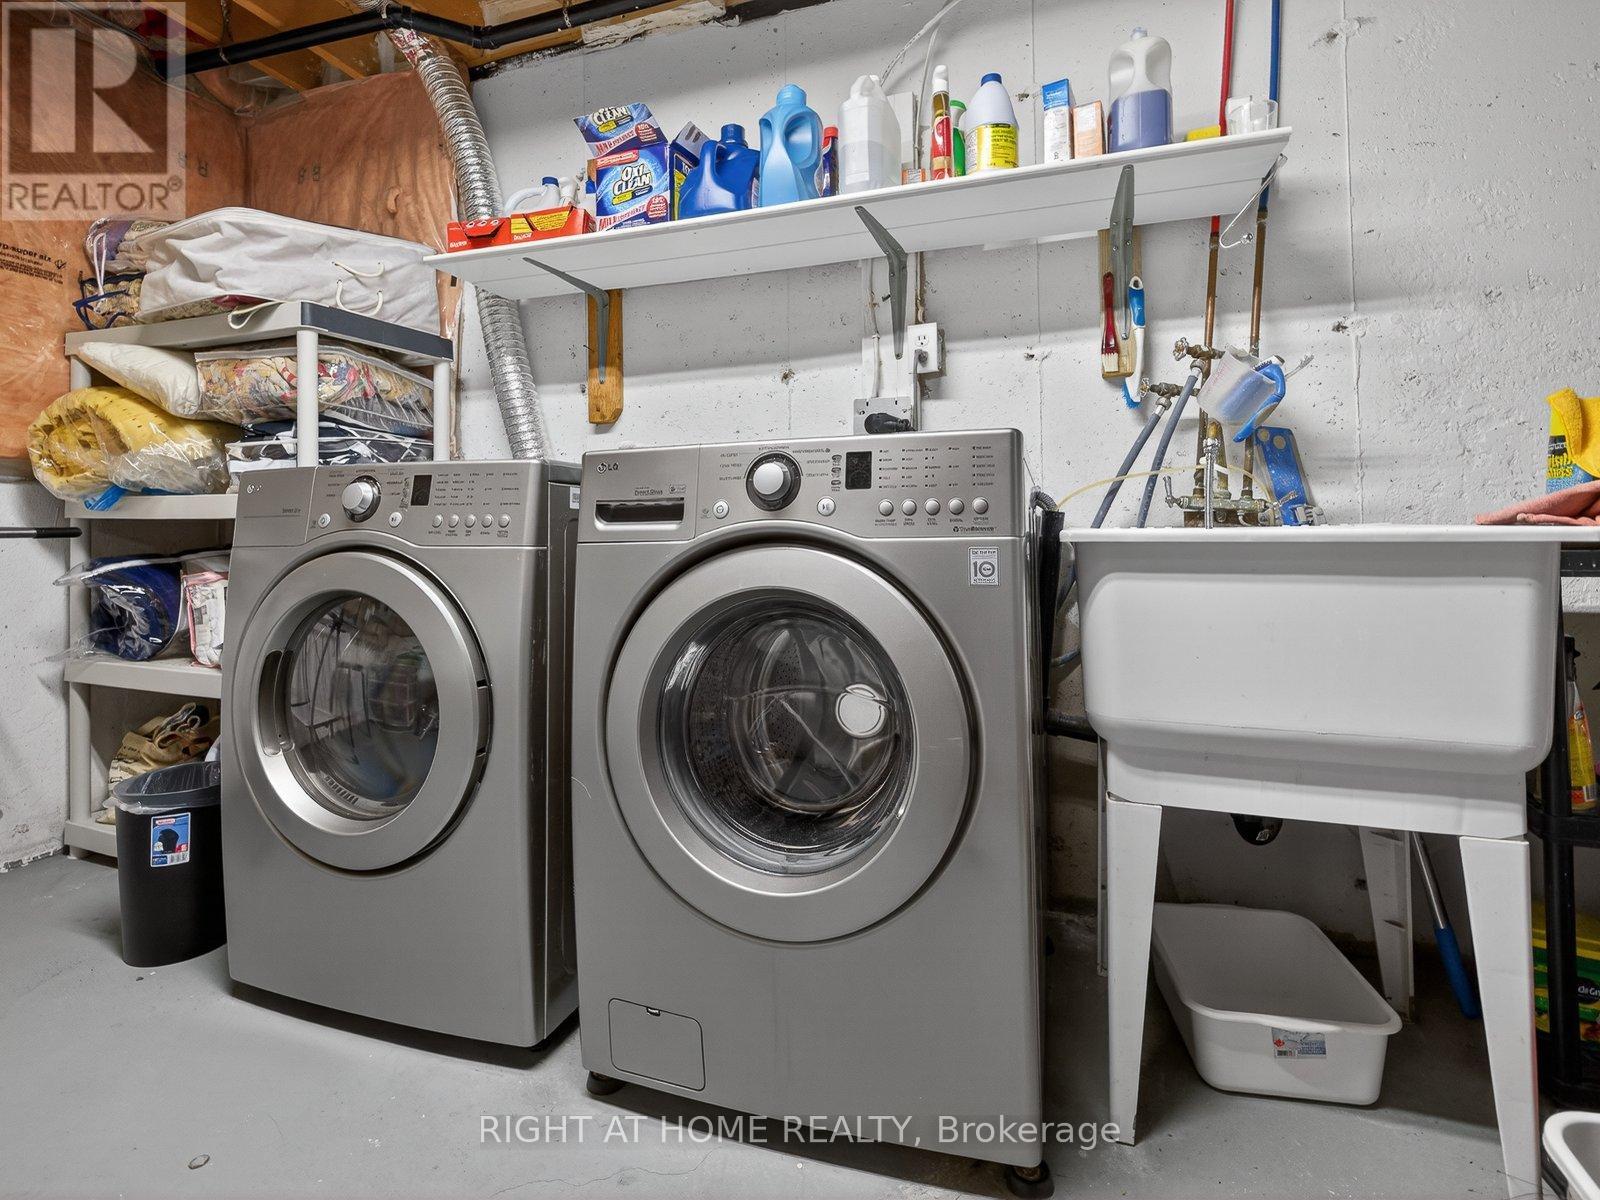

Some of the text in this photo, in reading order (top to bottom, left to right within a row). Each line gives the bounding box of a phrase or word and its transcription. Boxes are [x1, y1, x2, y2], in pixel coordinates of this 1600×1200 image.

[593, 105, 628, 126] CLEAN
[621, 163, 646, 181] OXI
[612, 172, 653, 196] CLEAN
[972, 560, 996, 578] 10
